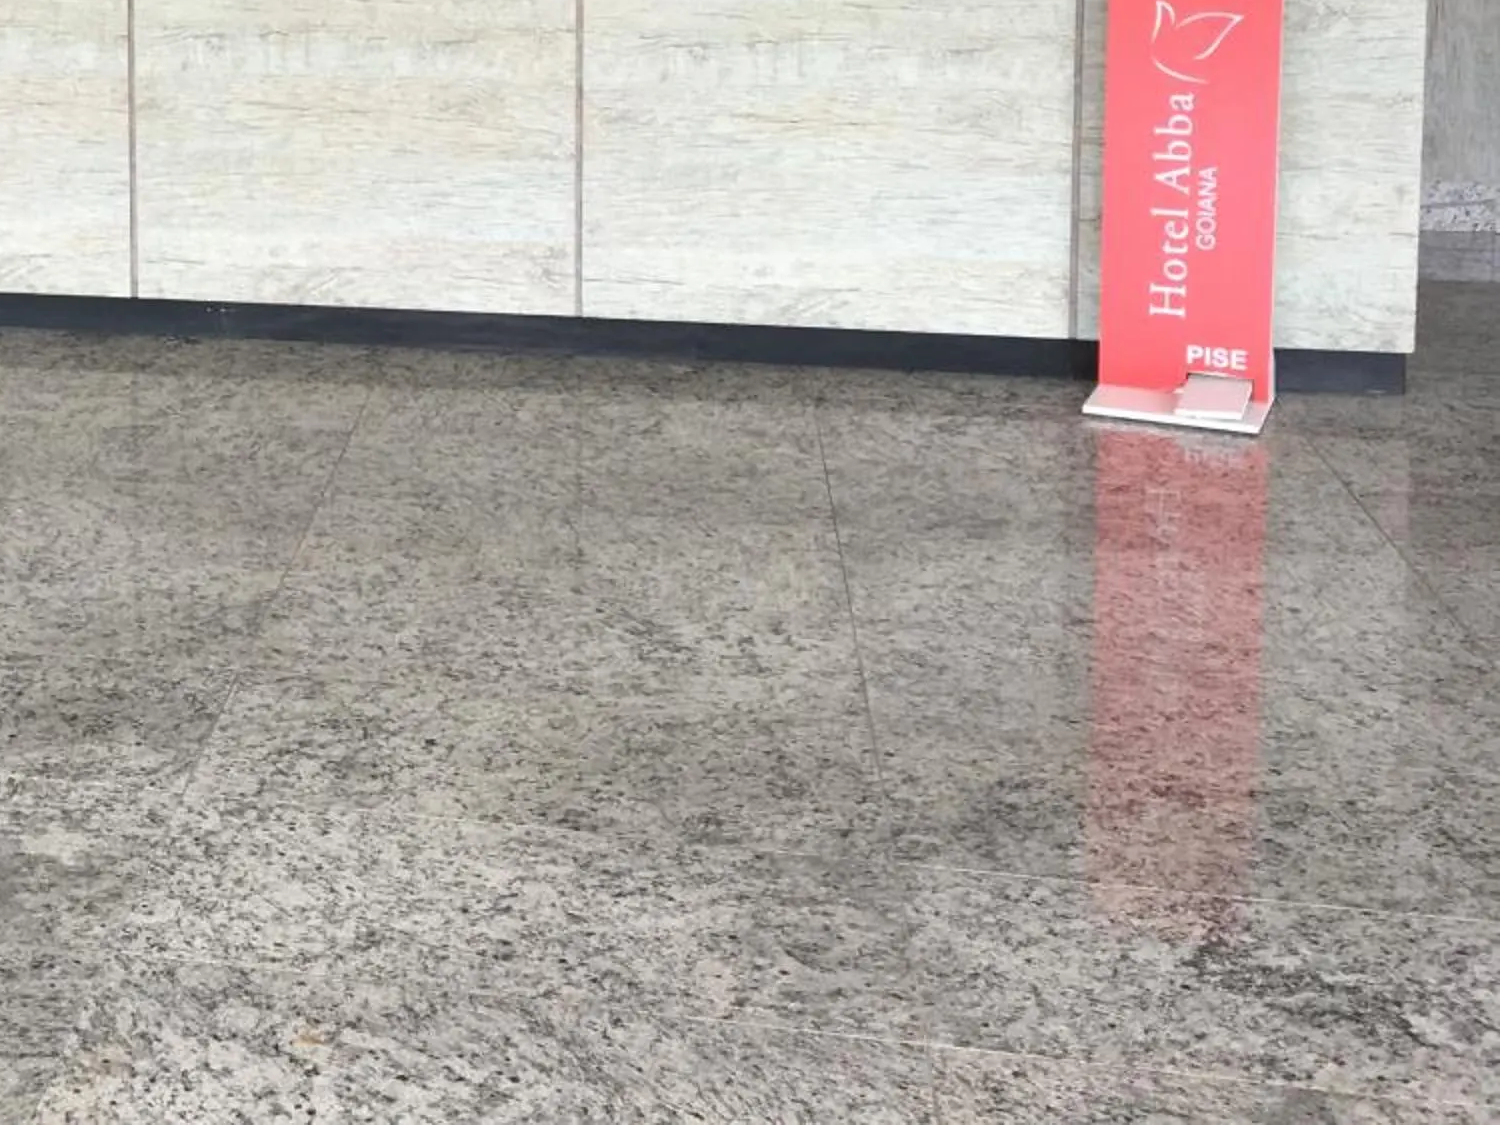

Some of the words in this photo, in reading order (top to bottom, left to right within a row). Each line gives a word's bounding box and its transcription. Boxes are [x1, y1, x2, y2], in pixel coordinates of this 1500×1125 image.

[1153, 93, 1195, 194] Abba
[1195, 166, 1218, 251] GOIANA
[1149, 208, 1189, 318] Hotel
[1186, 344, 1248, 371] PISE
